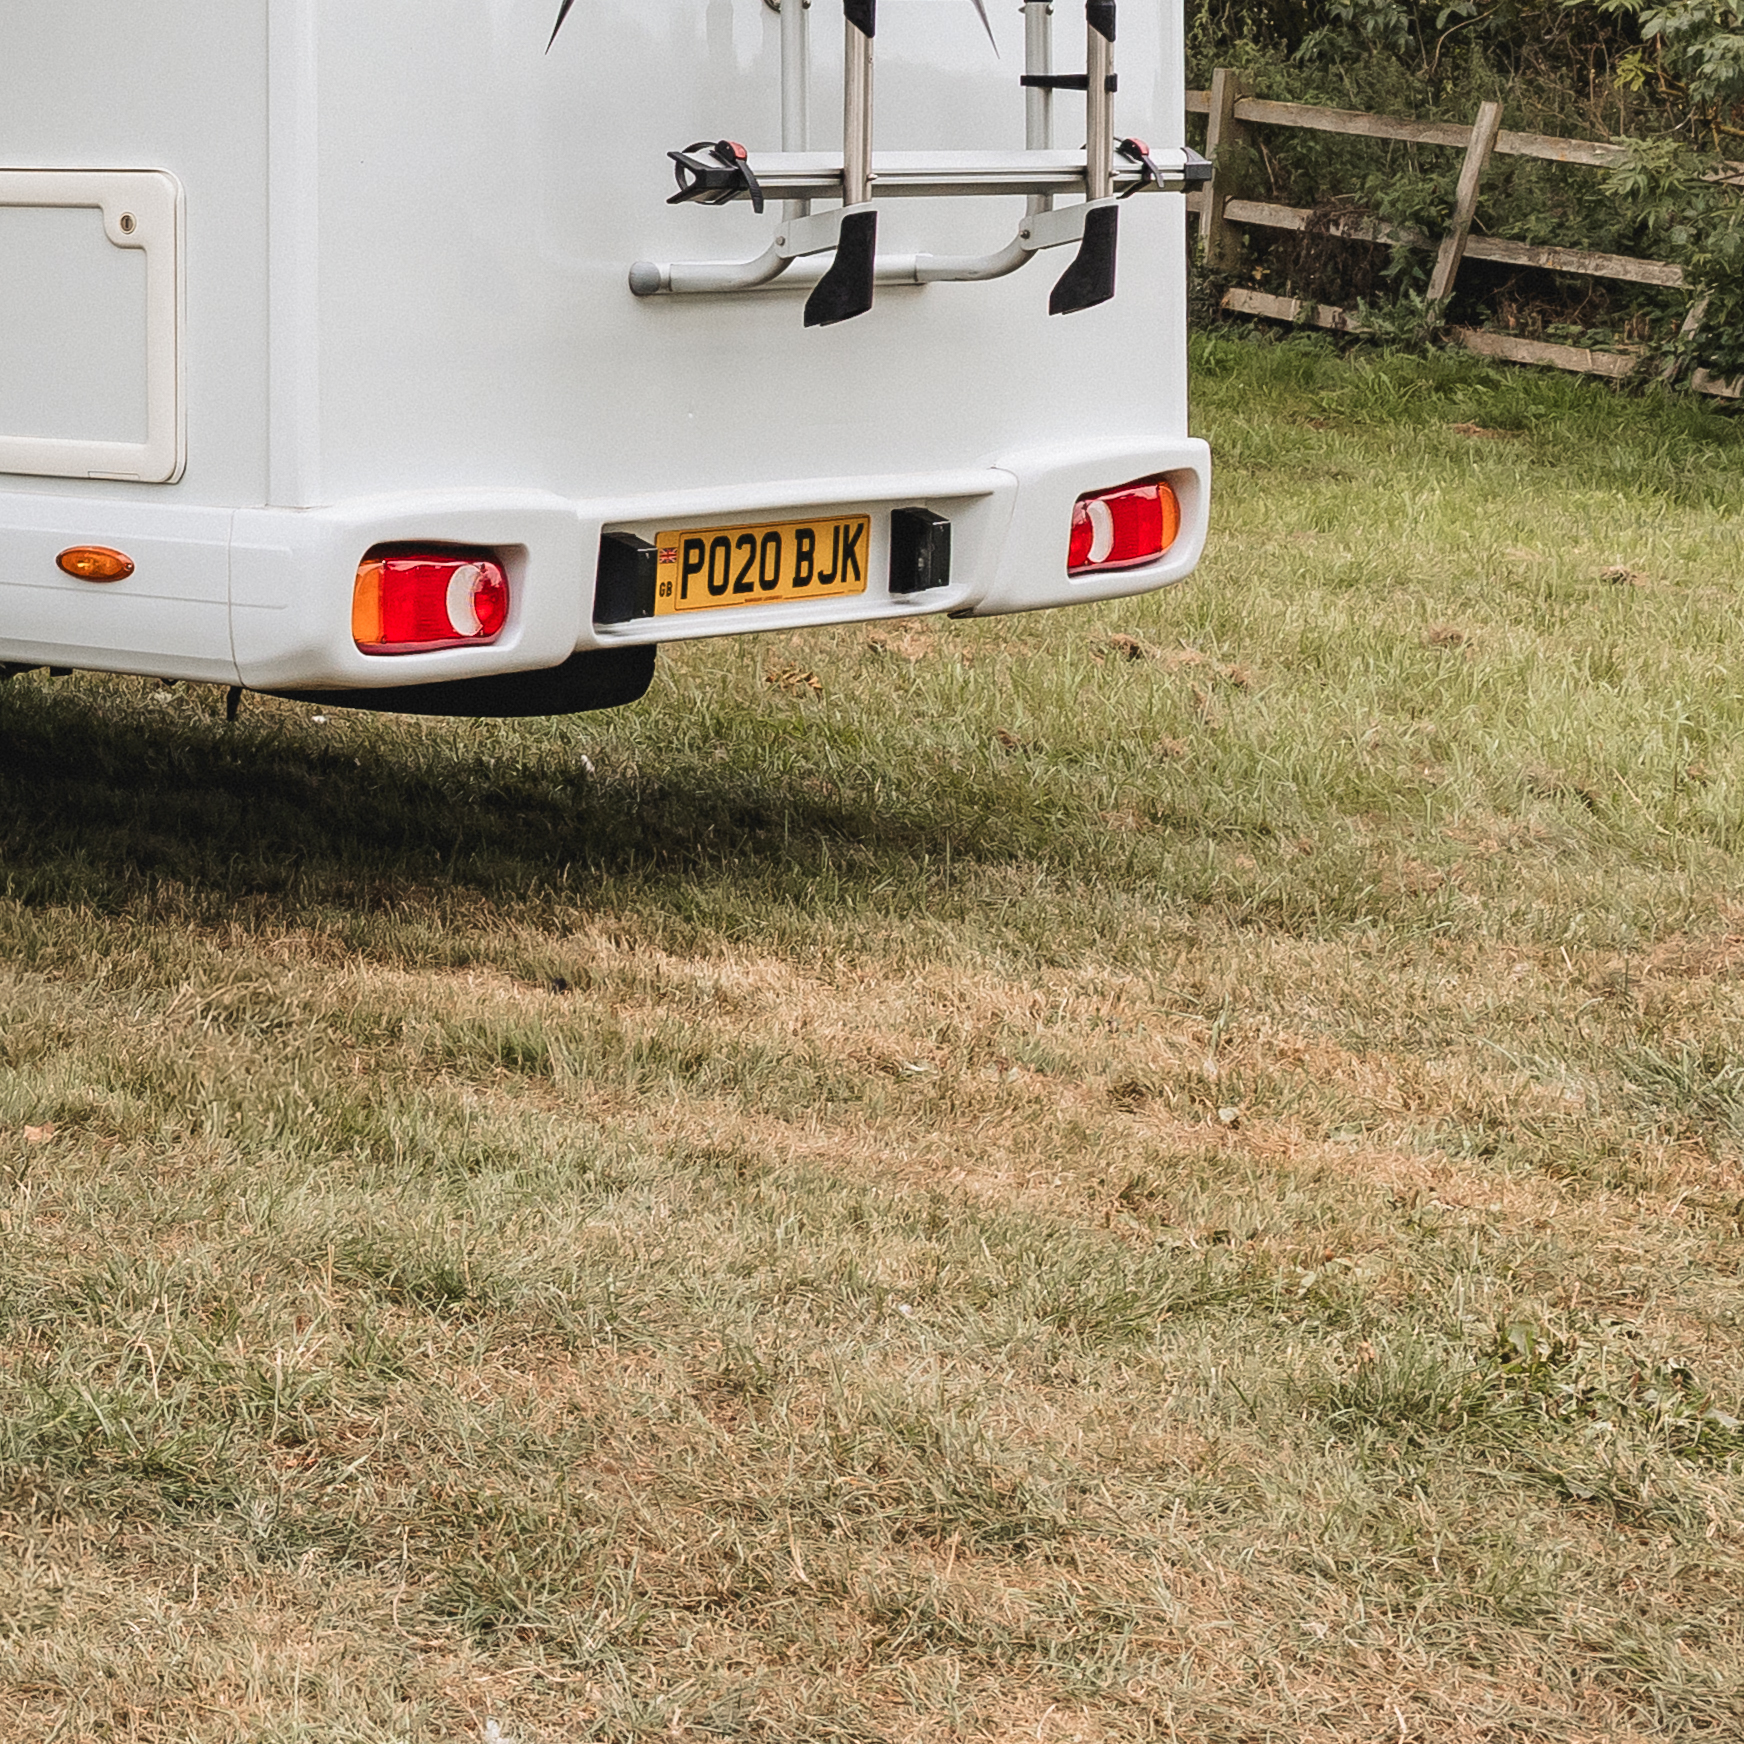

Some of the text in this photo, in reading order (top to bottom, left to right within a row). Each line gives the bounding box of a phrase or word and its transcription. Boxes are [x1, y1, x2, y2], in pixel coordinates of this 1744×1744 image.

[680, 523, 864, 600] PO20 BJK
[659, 581, 673, 598] GB
